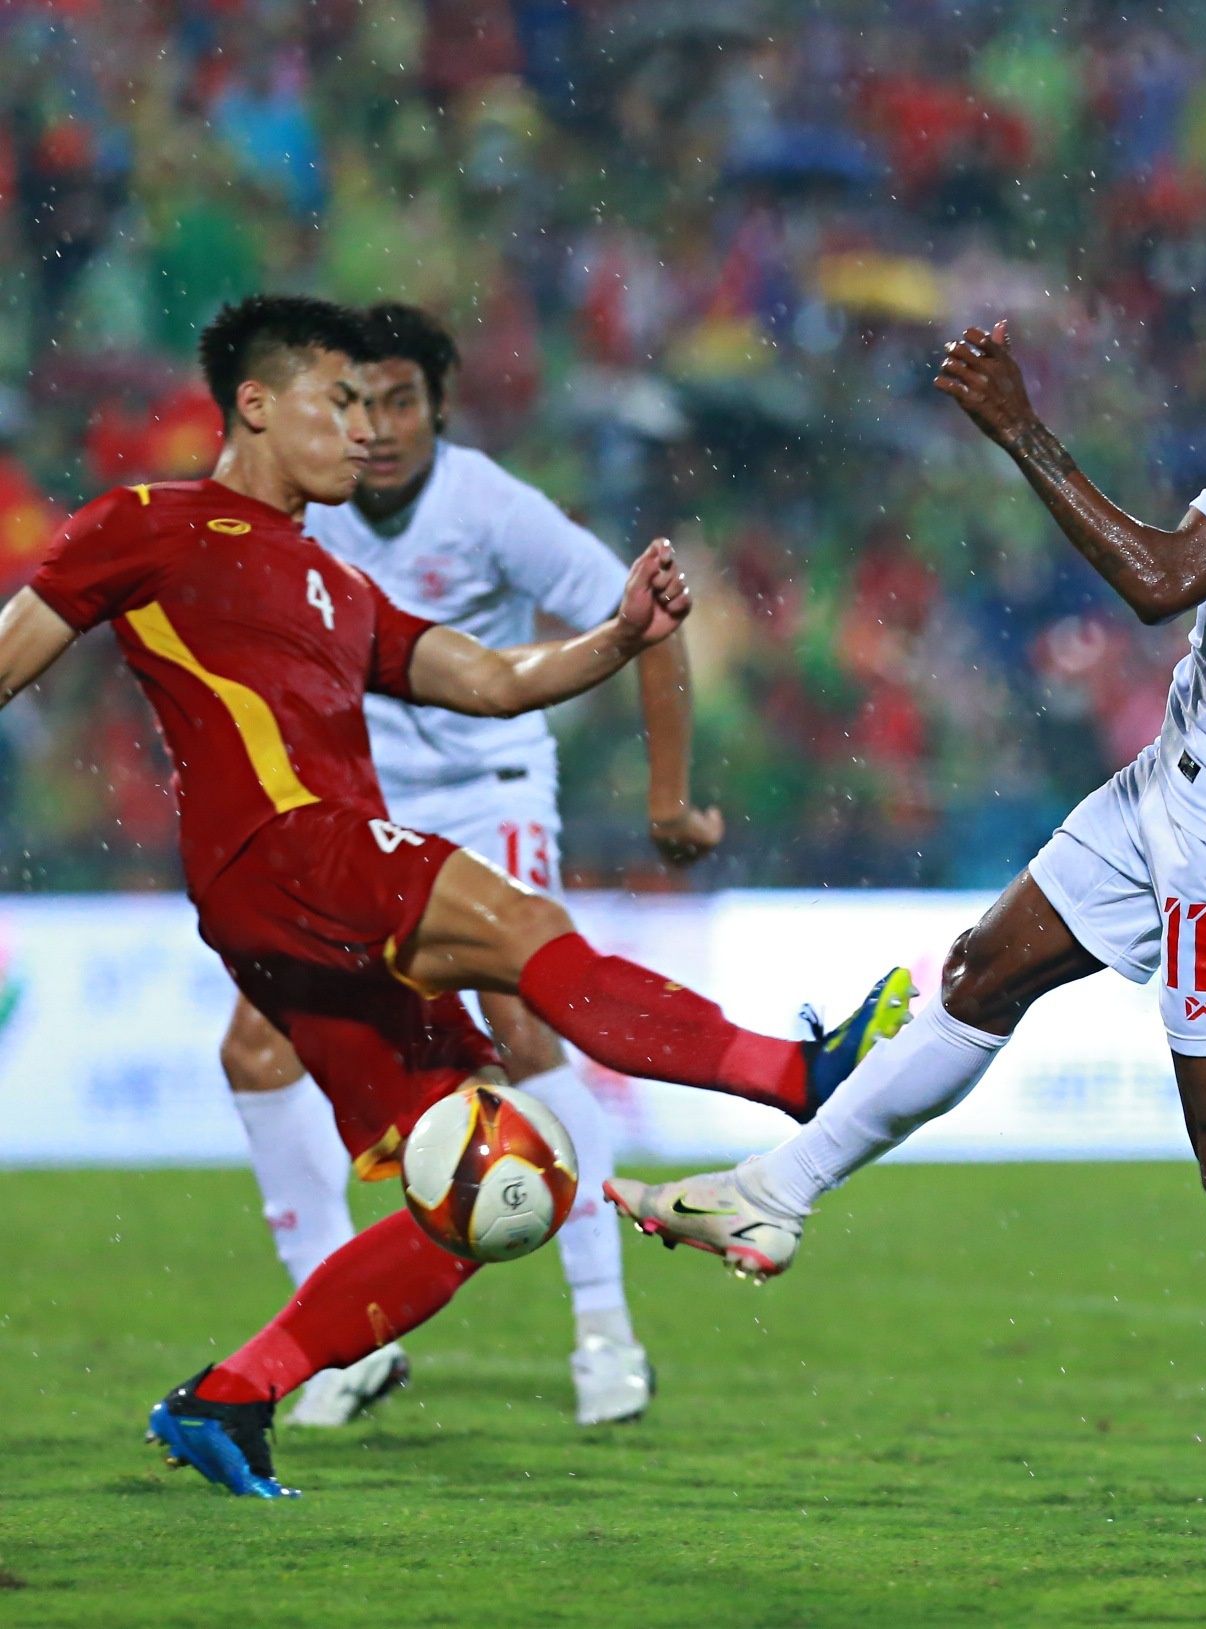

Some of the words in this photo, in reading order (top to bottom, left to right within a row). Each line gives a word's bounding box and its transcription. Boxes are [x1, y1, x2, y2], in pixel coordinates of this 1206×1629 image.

[306, 568, 335, 631] 4
[368, 818, 425, 853] 4
[500, 820, 551, 889] 13
